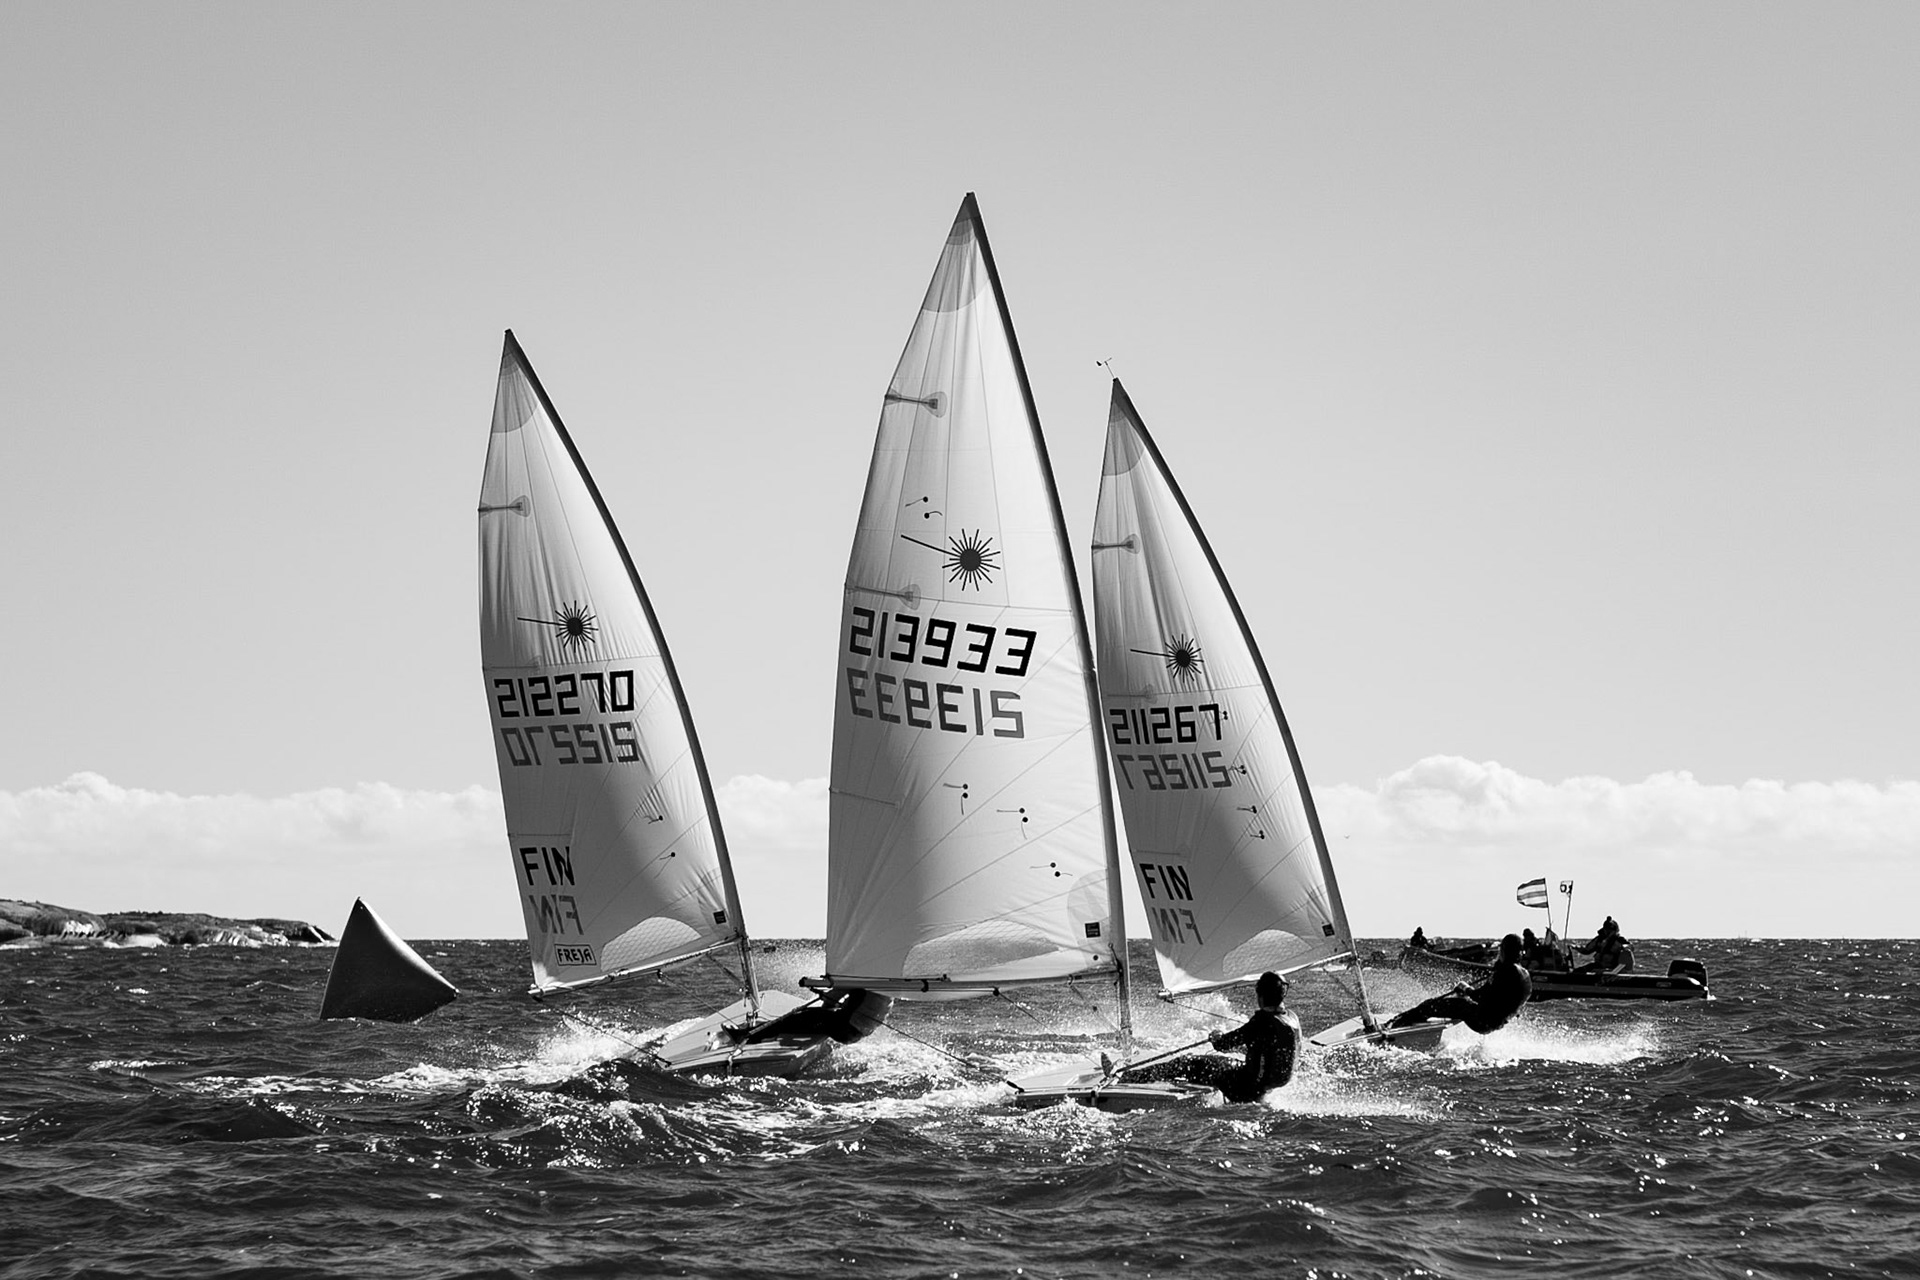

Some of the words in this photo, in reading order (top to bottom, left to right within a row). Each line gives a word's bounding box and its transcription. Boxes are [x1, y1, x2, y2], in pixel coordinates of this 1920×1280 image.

[849, 606, 1037, 677] 213933
[494, 670, 634, 717] 212270
[1109, 703, 1222, 744] 211267
[520, 846, 575, 885] FIN
[1139, 863, 1193, 901] FIN
[557, 948, 592, 963] FREJA
